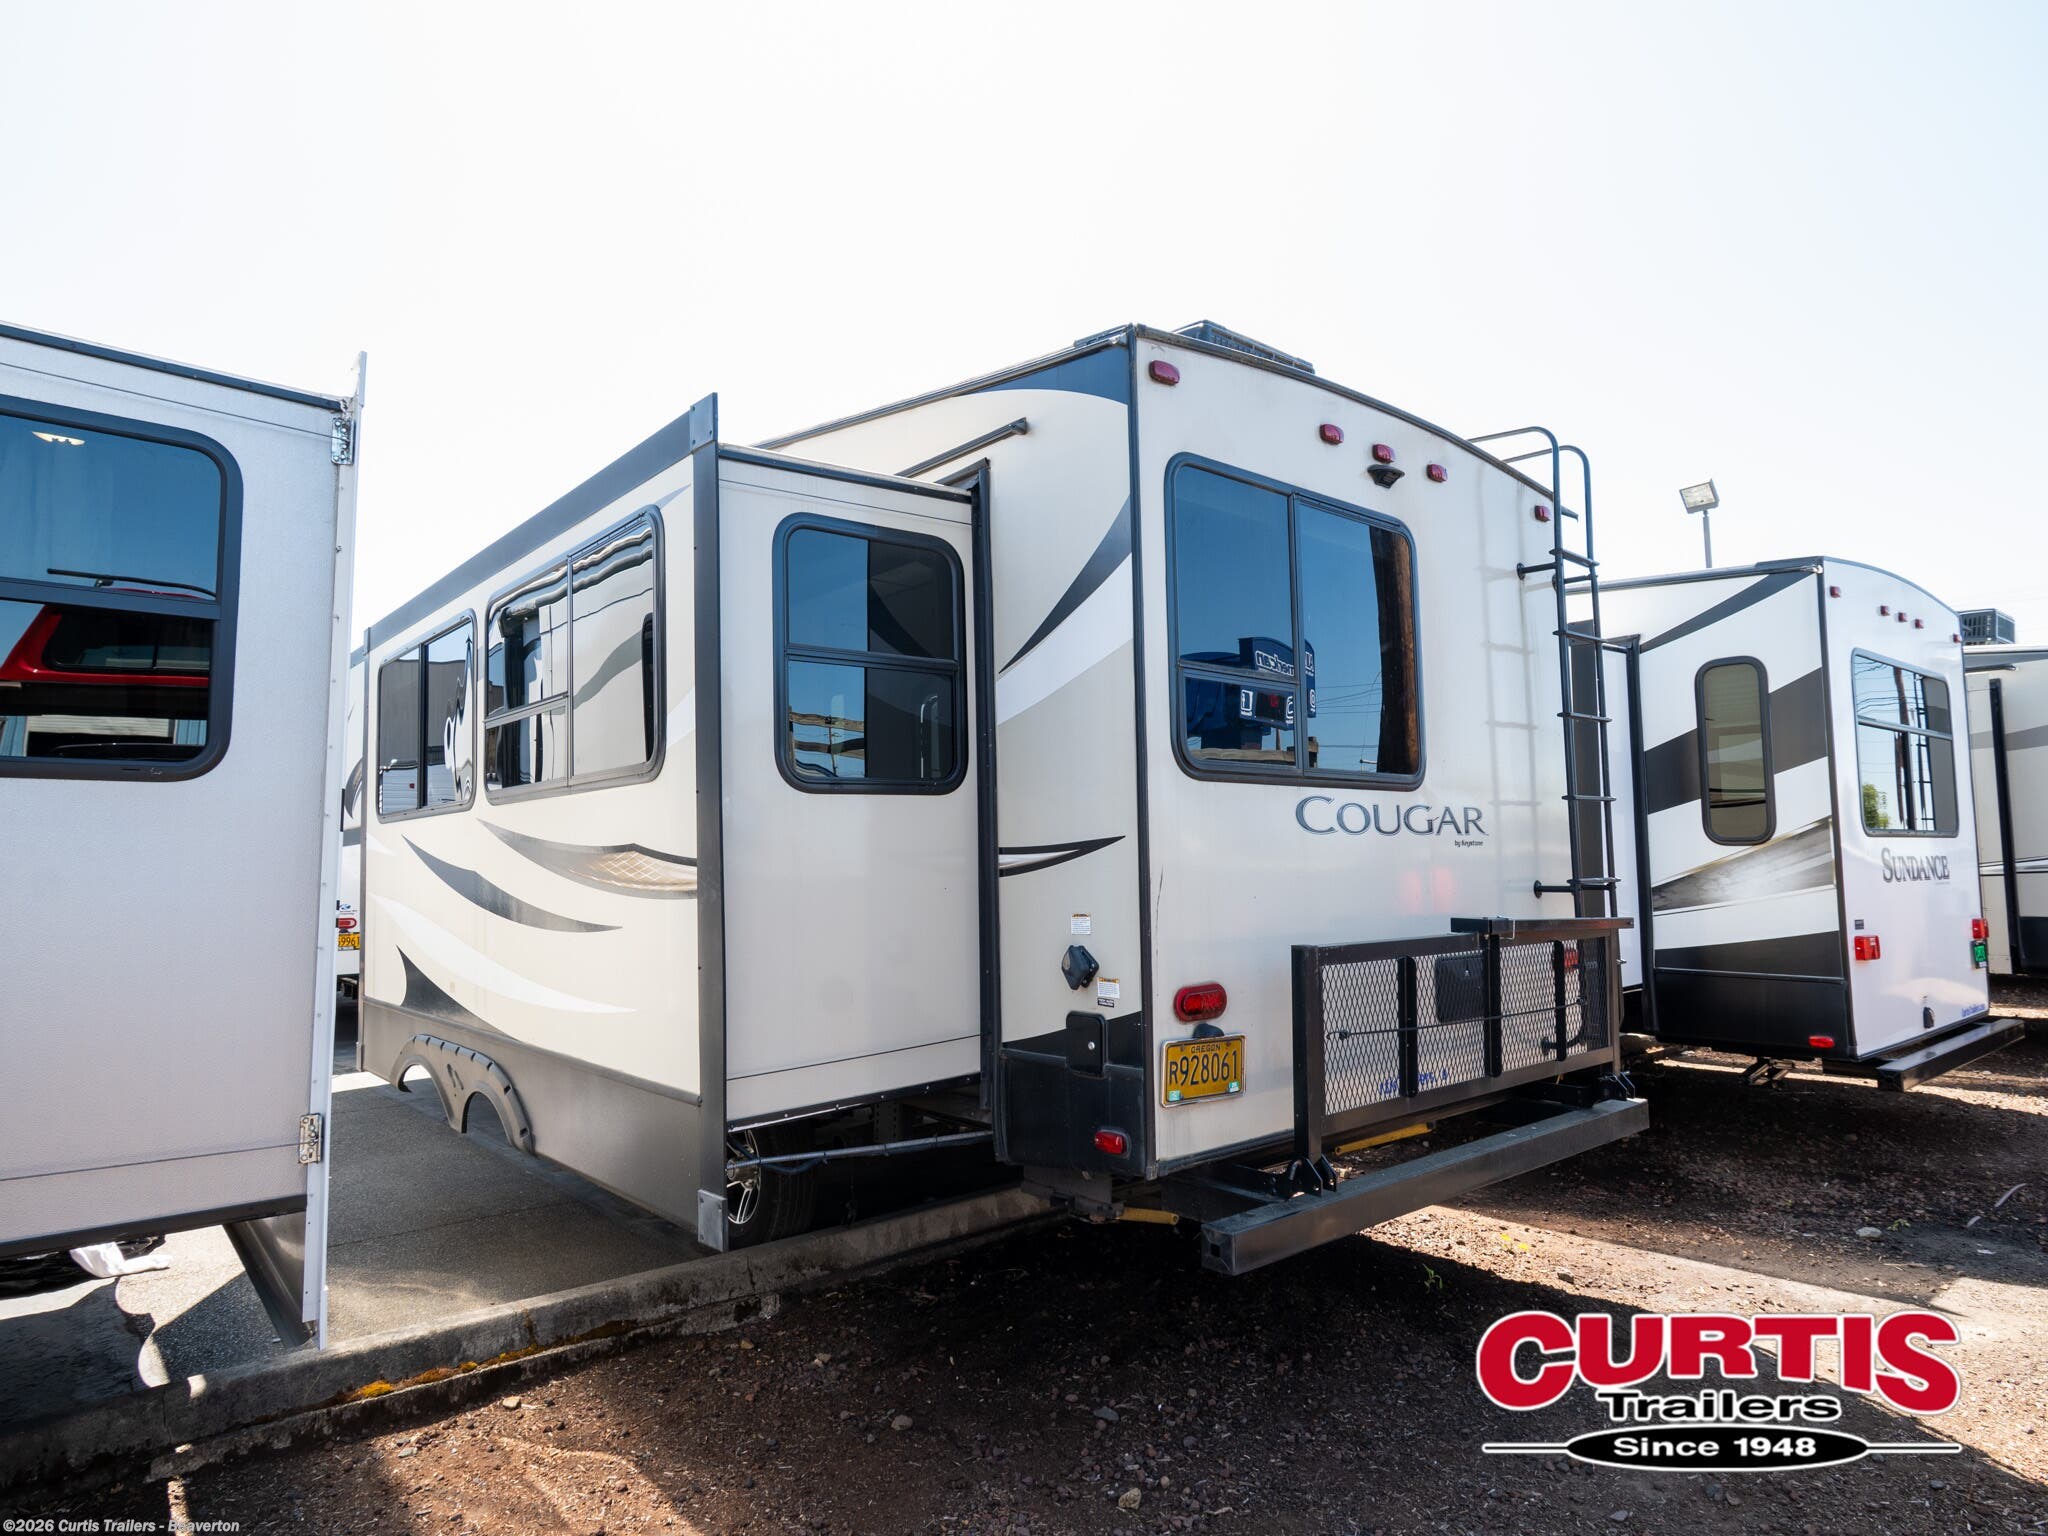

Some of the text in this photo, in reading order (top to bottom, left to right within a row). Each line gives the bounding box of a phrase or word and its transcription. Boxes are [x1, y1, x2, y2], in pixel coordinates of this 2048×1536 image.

[1295, 795, 1488, 836] COUGAR
[1881, 847, 1951, 883] SUNDANCE
[1191, 1043, 1221, 1054] OREGON
[1169, 1050, 1238, 1087] R928061
